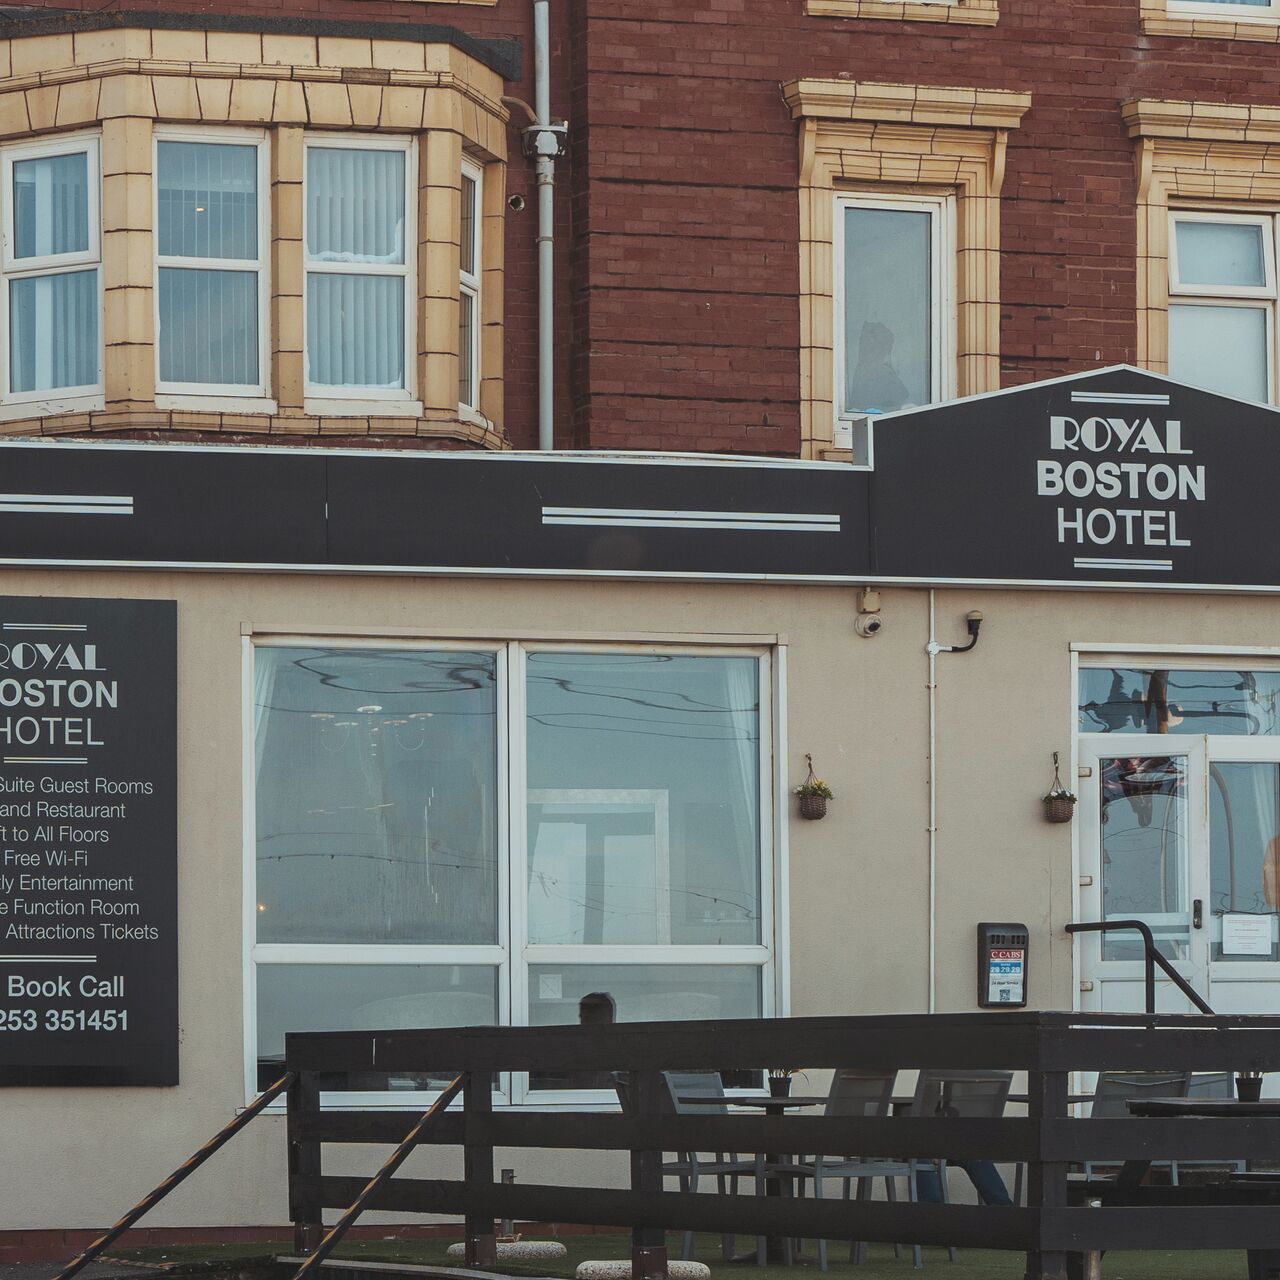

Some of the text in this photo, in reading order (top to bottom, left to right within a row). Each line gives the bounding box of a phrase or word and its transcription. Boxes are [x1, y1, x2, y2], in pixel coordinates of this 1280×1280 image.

[1049, 415, 1194, 455] ROYAL
[1036, 459, 1206, 501] BOSTON
[1056, 506, 1192, 547] HOTEL
[39, 776, 91, 794] Guest
[95, 777, 154, 795] Rooms
[0, 800, 31, 818] and
[36, 800, 127, 819] Restaurant
[12, 826, 30, 842] to
[33, 825, 54, 843] All
[59, 825, 110, 843] Floors
[4, 849, 88, 867] Free Wi-Fi
[19, 873, 134, 892] Entertainment
[13, 898, 85, 916] Function
[90, 898, 140, 916] Room
[5, 922, 96, 941] Attractions
[99, 922, 159, 940] Tickets
[7, 974, 72, 998] Book
[78, 974, 125, 998] Call
[44, 1008, 128, 1032] 351451
